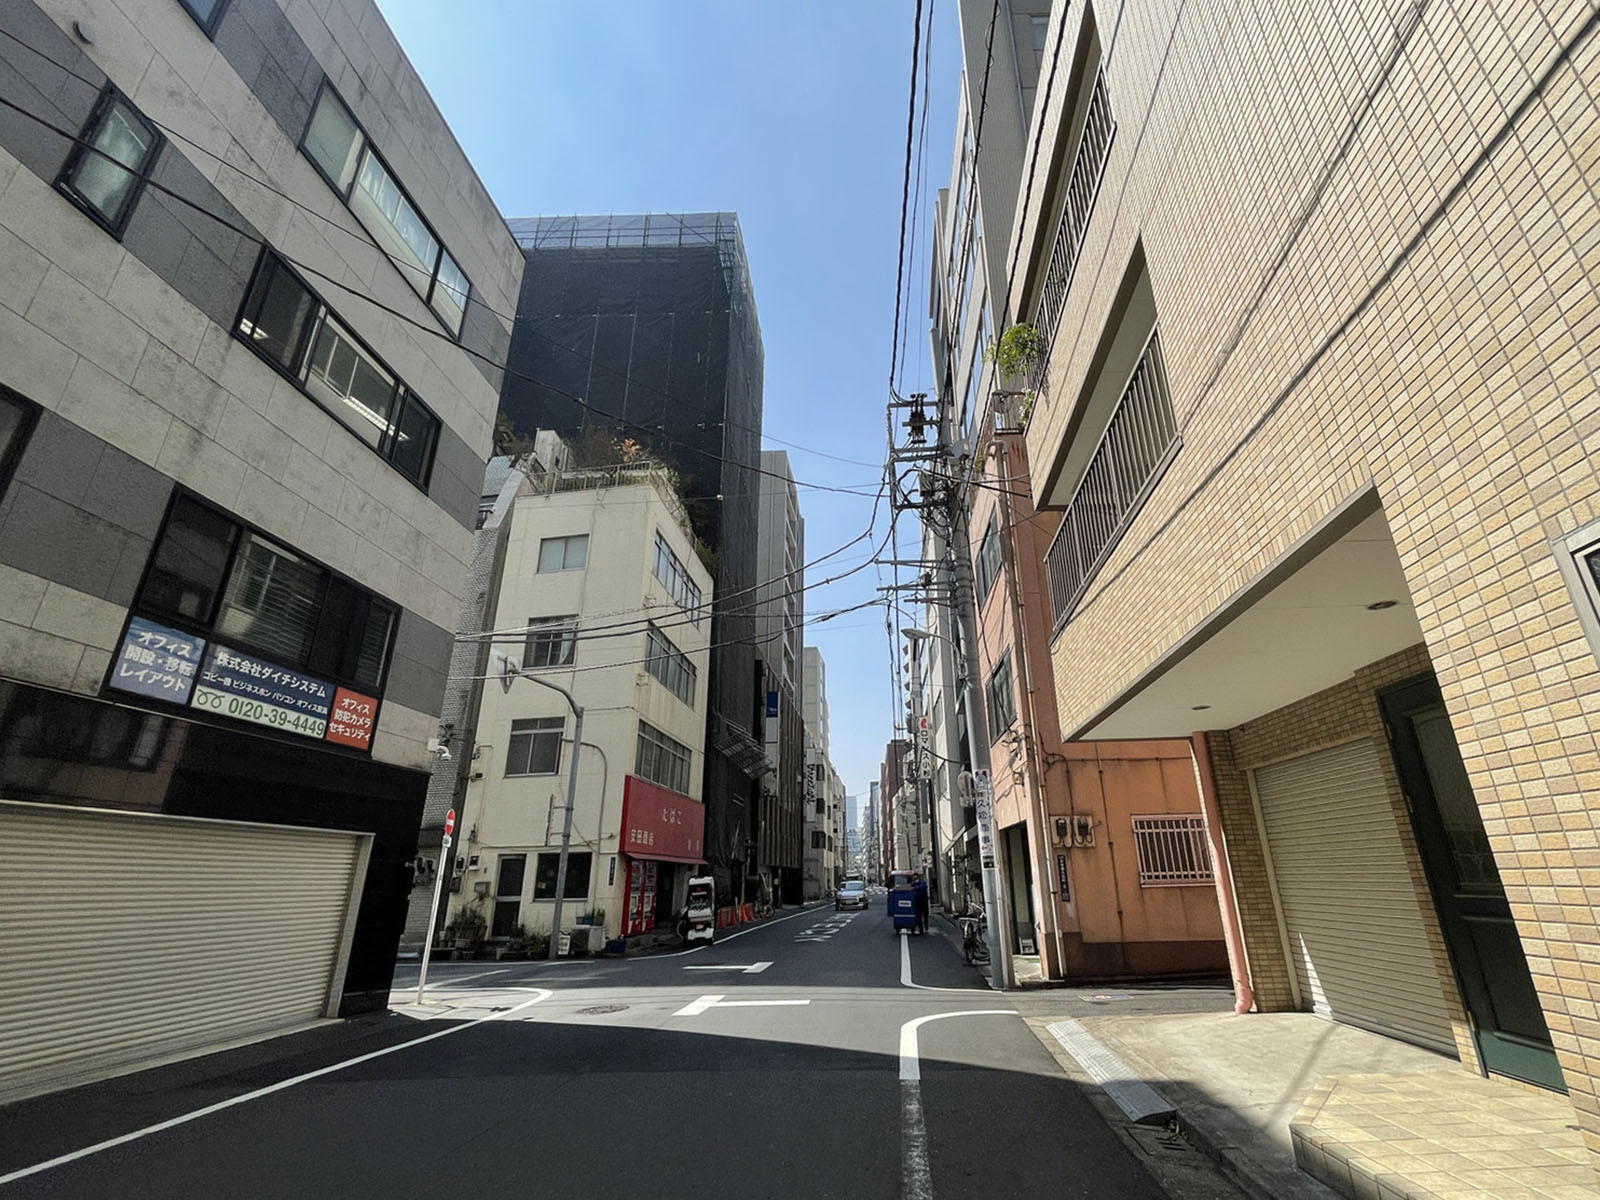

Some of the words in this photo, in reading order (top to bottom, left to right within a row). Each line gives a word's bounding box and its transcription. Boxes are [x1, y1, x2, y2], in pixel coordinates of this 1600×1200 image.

[138, 632, 191, 658] オフィス
[124, 644, 193, 676] 開設・移転
[120, 663, 185, 691] レイアウト
[216, 652, 326, 698] 株式会社ダイチシステム
[232, 679, 272, 697] ビジネスホン
[273, 692, 296, 705] パソコン
[228, 698, 324, 736] 0120-39-4449
[334, 708, 371, 729] 防犯カメラ
[341, 697, 370, 715] オフィス
[329, 722, 371, 741] セキュリティ
[662, 808, 682, 824] たばこ
